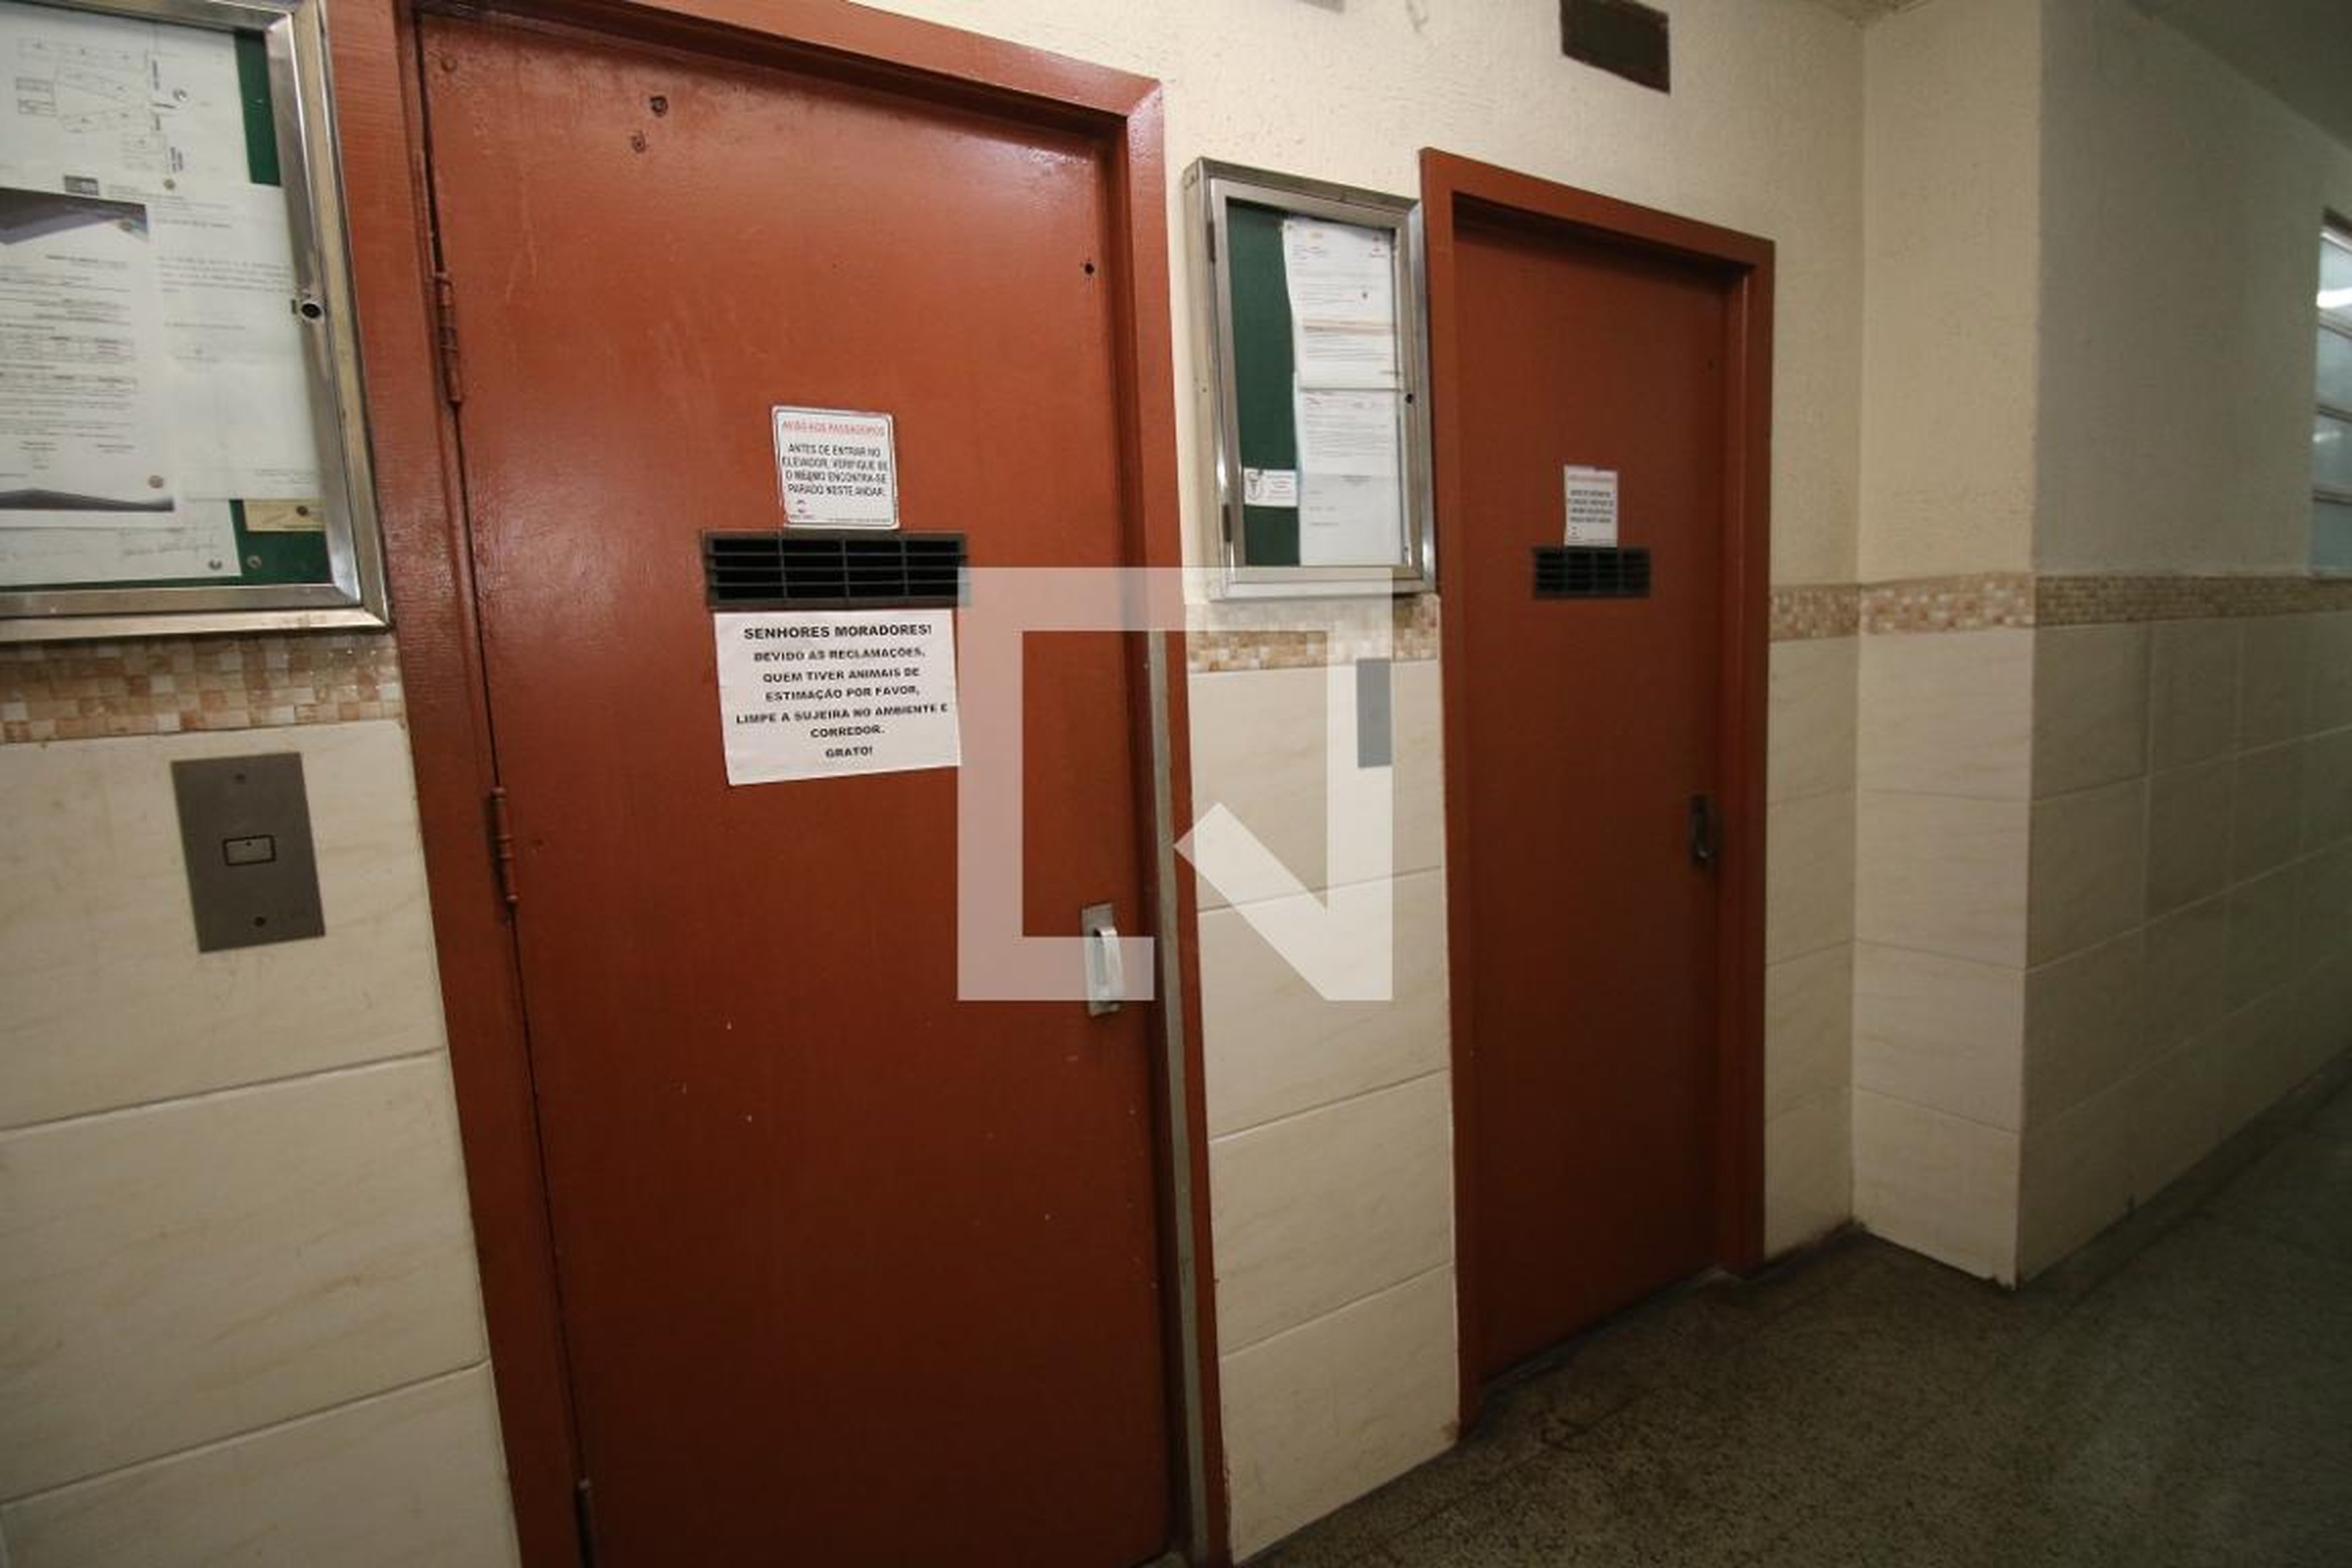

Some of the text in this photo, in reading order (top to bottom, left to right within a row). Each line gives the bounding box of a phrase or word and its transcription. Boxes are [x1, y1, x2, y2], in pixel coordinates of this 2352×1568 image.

[788, 443, 881, 458] ANTES DE ENTRAR NO
[786, 469, 793, 480] O
[788, 483, 824, 495] PARADO
[826, 484, 853, 497] NESTE
[744, 624, 932, 639] SENHORES MORADORES!
[753, 651, 805, 662] DEVIDO
[763, 667, 920, 683] QUEM TIVER ANIMAIS DE
[765, 685, 920, 703] ESTIMAÇÃO POR FAVOR,
[736, 703, 948, 725] LIMPE A SUJEIRA NO AMBIENTE E
[810, 724, 886, 738] CORREDOR.
[825, 745, 873, 758] GRATO!
